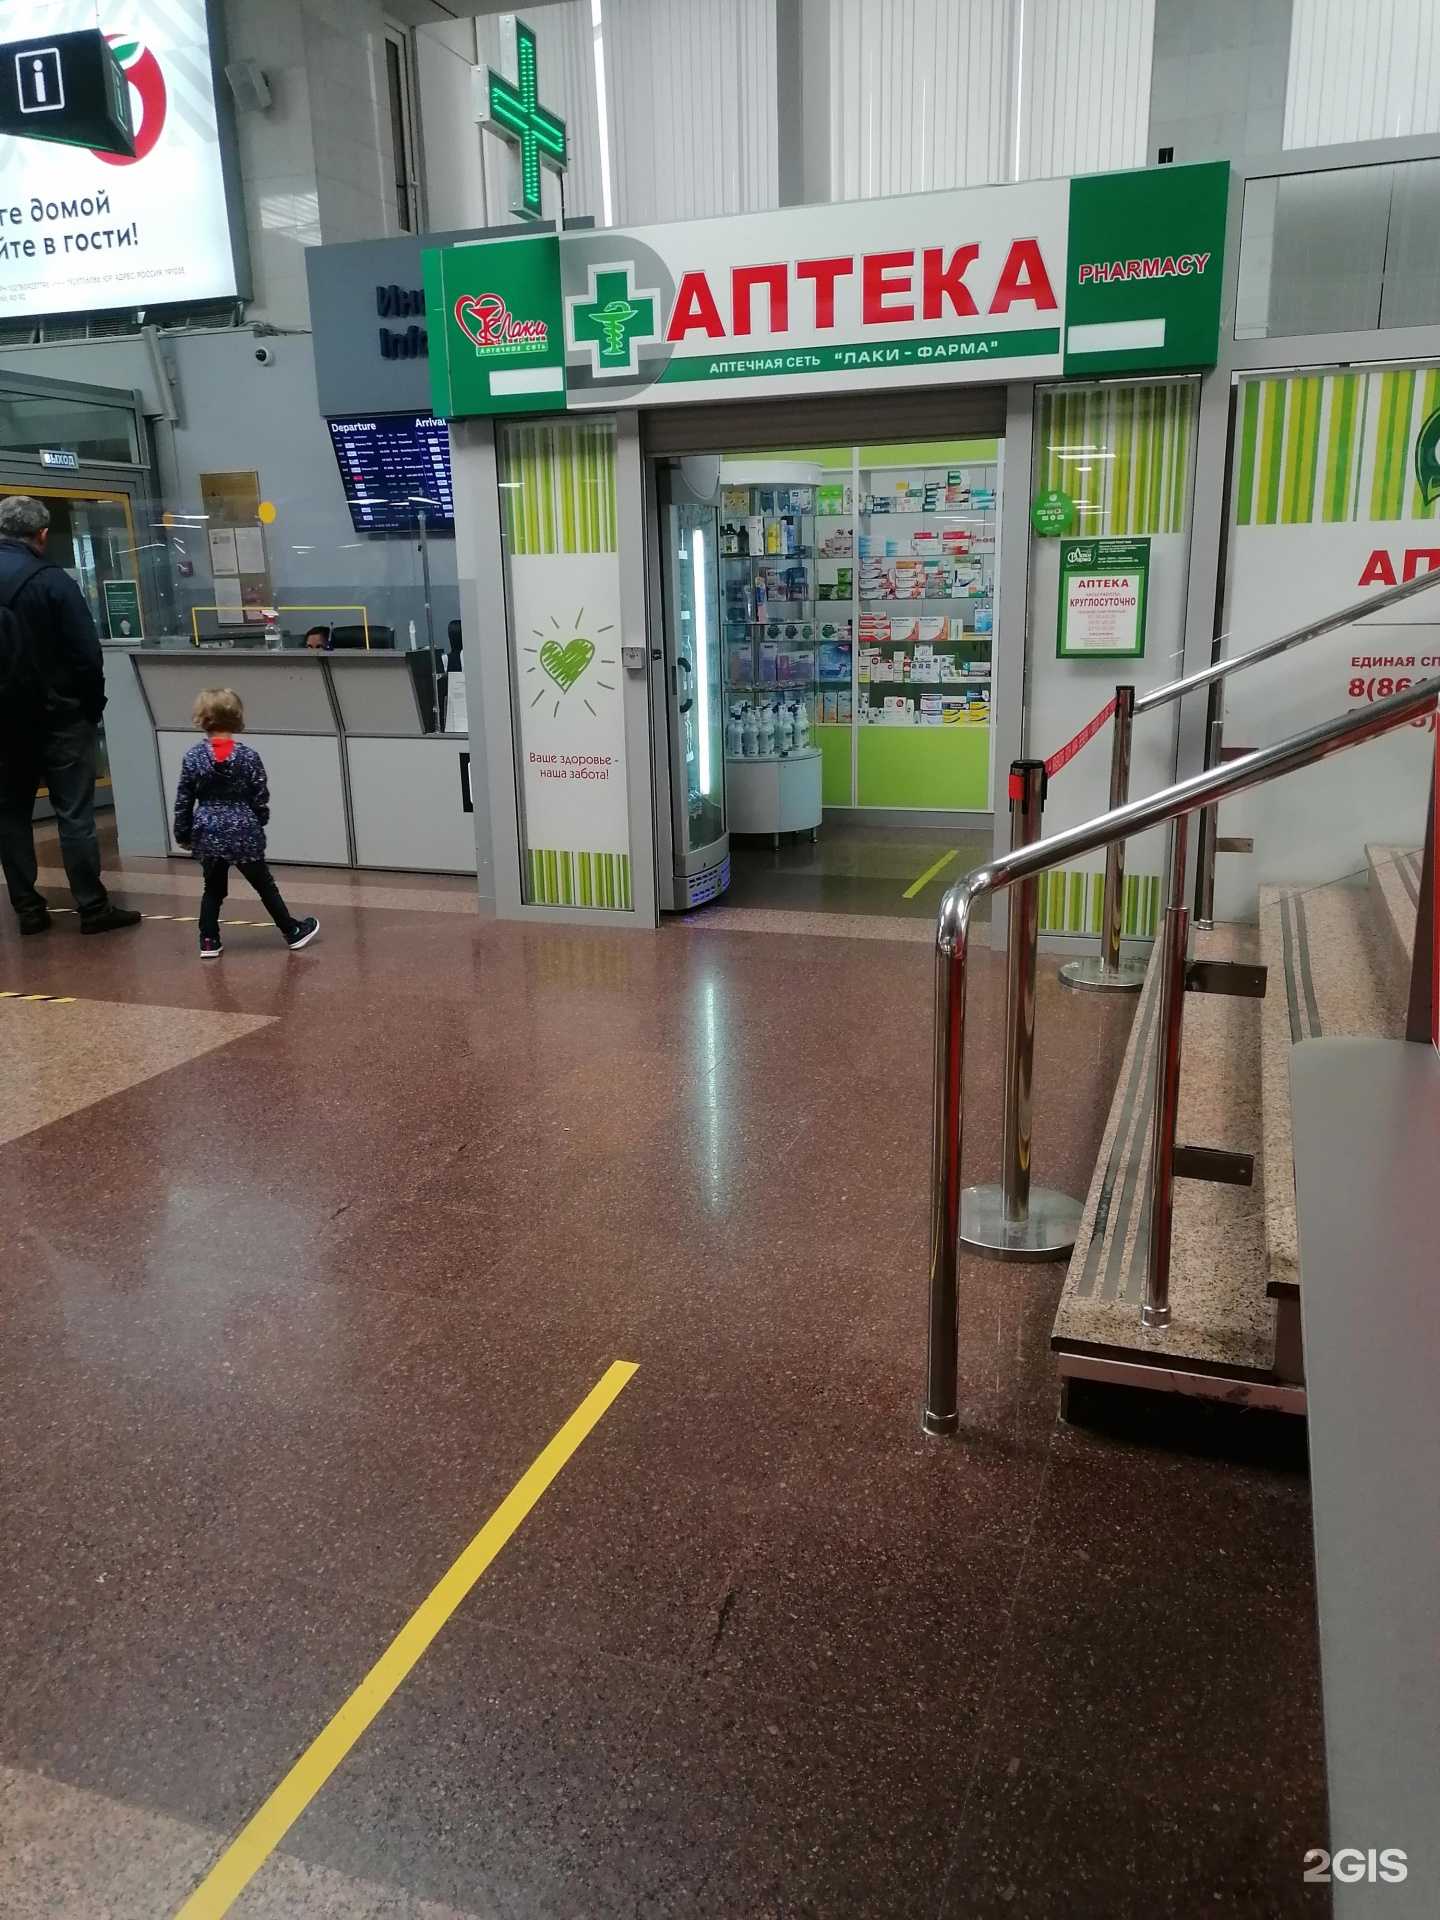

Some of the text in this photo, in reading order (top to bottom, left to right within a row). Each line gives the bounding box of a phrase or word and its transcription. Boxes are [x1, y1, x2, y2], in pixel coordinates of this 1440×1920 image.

[30, 189, 110, 222] домой
[44, 237, 56, 255] в
[64, 222, 138, 253] гости!
[1079, 253, 1211, 284] PHARMACY
[665, 236, 1059, 343] АПТЕКА
[709, 358, 783, 374] АПТЕЧНАЯ
[786, 355, 821, 368] СЕТЬ
[331, 422, 377, 434] Departure
[44, 453, 75, 466] ВЫХОД
[1078, 579, 1129, 588] АПТЕКА
[1070, 597, 1136, 607] КРУГЛОСУТОЧНО
[1351, 656, 1415, 668] ЕДИНАЯ
[1348, 677, 1429, 702] 8(86
[529, 752, 557, 763] Ваше
[560, 755, 612, 766] здоровье
[540, 767, 609, 780] наша забота!
